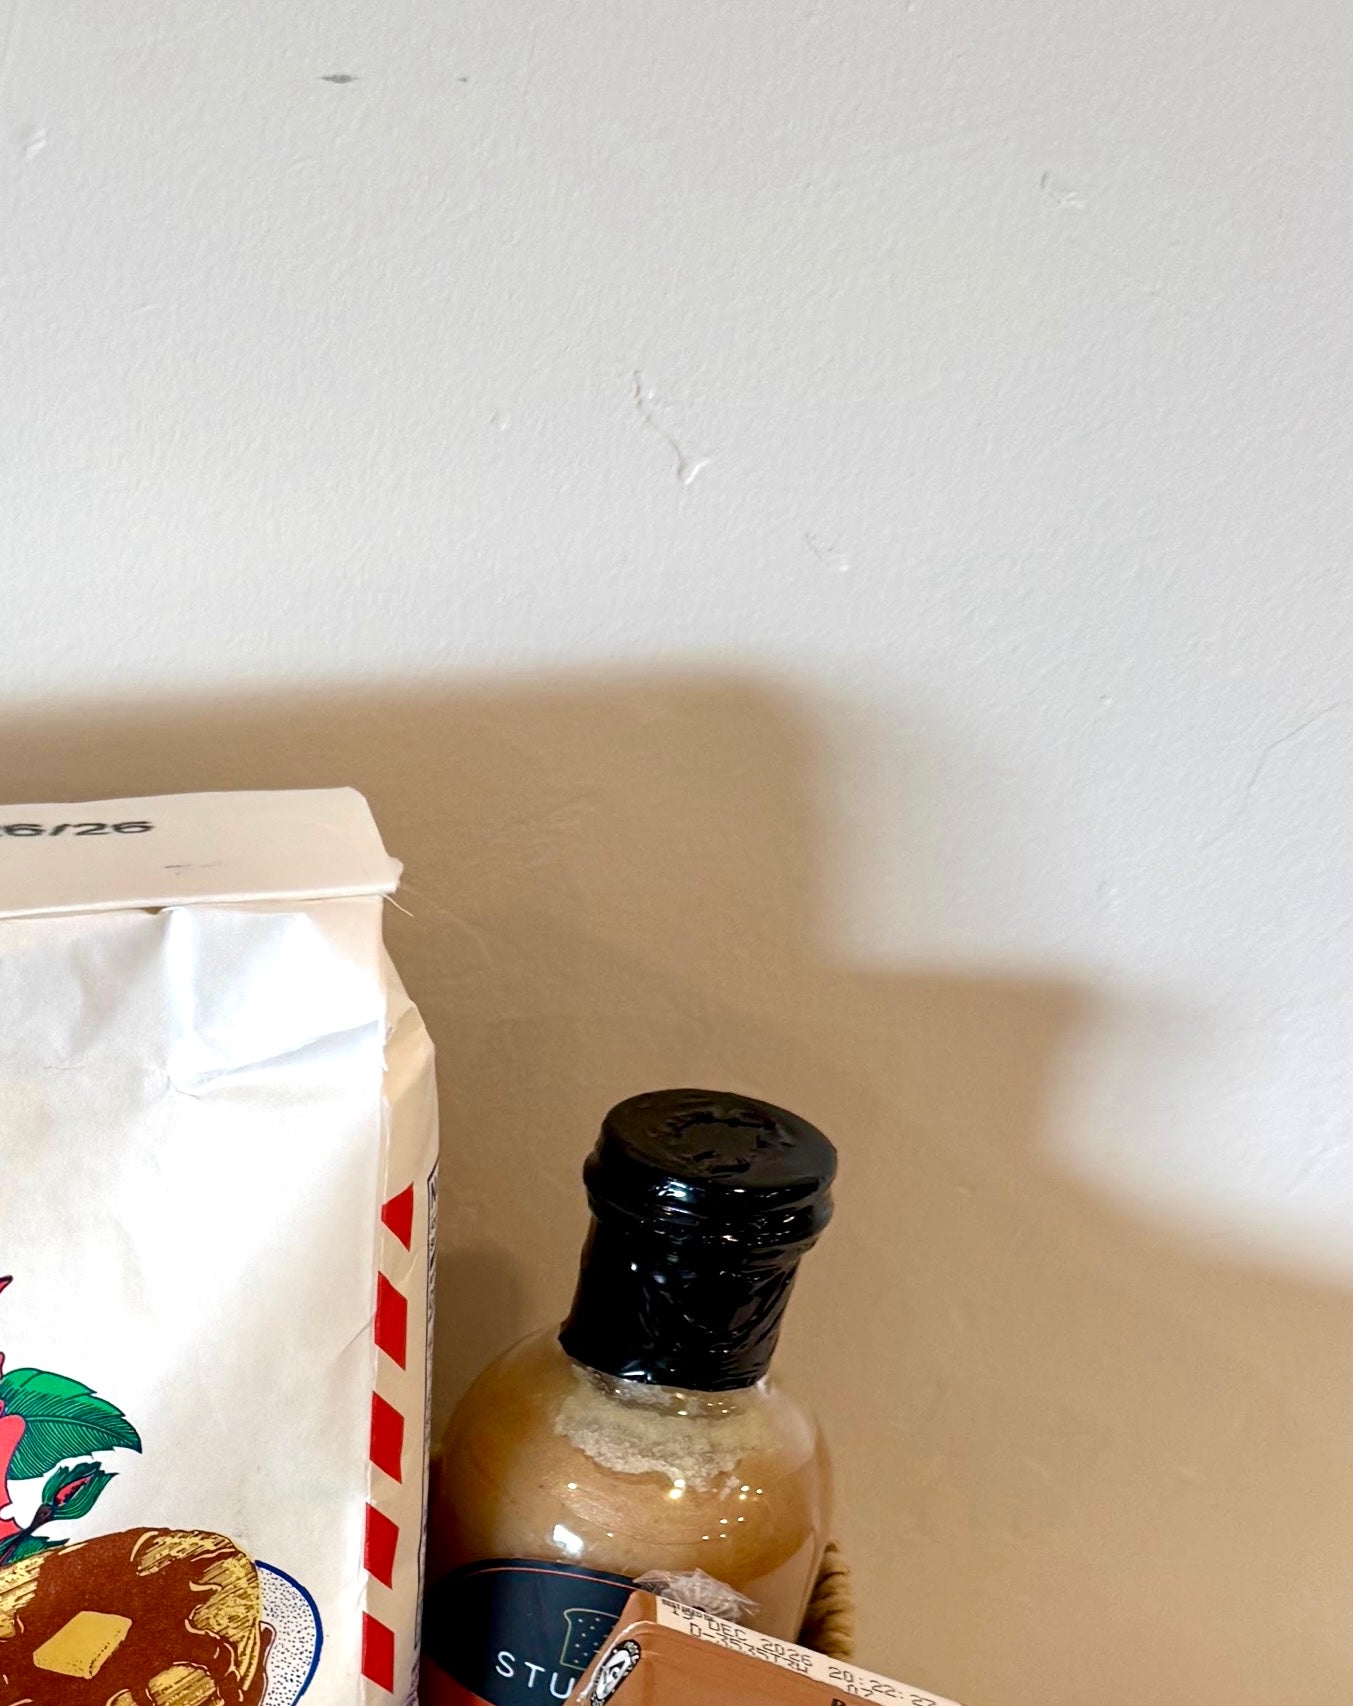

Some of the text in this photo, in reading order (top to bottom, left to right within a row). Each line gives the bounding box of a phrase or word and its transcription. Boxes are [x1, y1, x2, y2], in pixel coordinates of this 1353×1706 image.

[708, 1620, 748, 1641] DEC
[760, 1638, 813, 1667] 2026
[495, 1650, 575, 1699] STU
